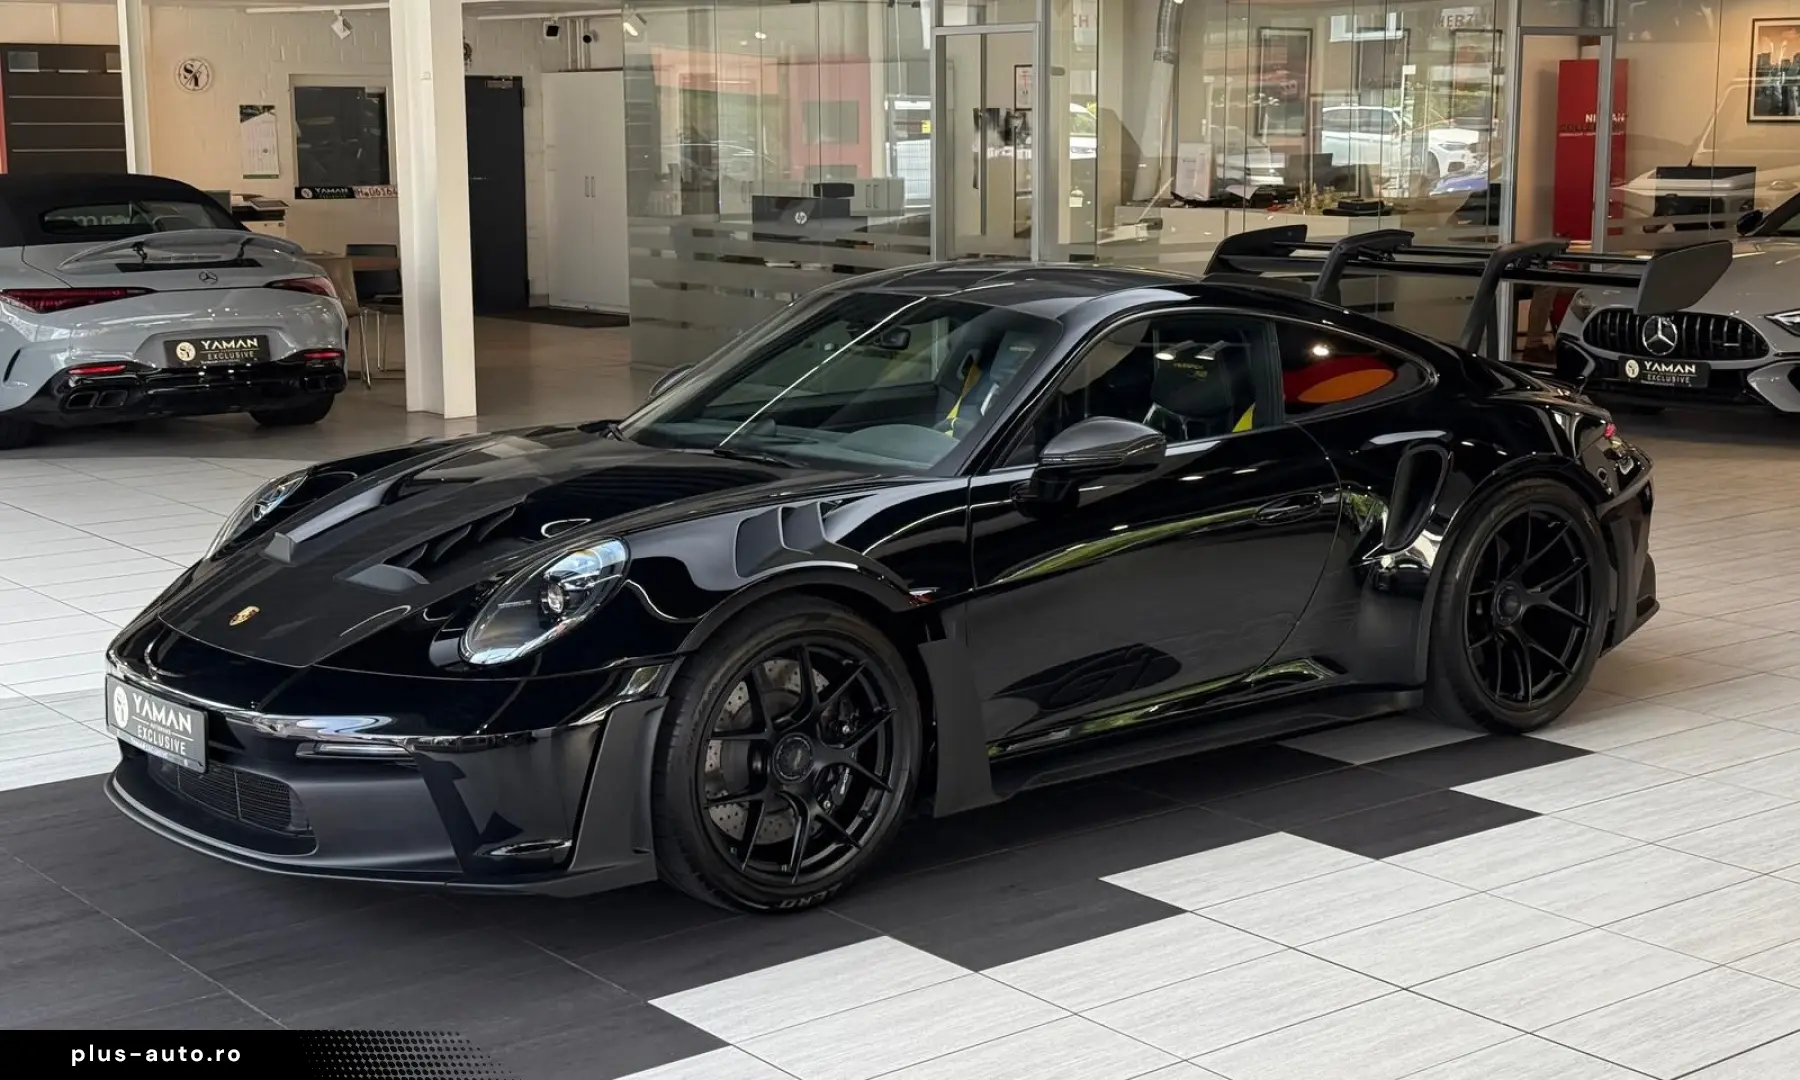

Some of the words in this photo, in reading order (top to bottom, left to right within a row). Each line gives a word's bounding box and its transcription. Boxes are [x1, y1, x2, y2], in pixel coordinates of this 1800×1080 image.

[200, 338, 258, 350] YAMAN
[207, 350, 255, 361] EXCLUSIVE
[1644, 360, 1696, 374] YAMAN
[1647, 374, 1690, 384] EXCLUSIVE
[132, 692, 192, 735] YAMAN
[137, 724, 187, 756] EXCLUSIVE
